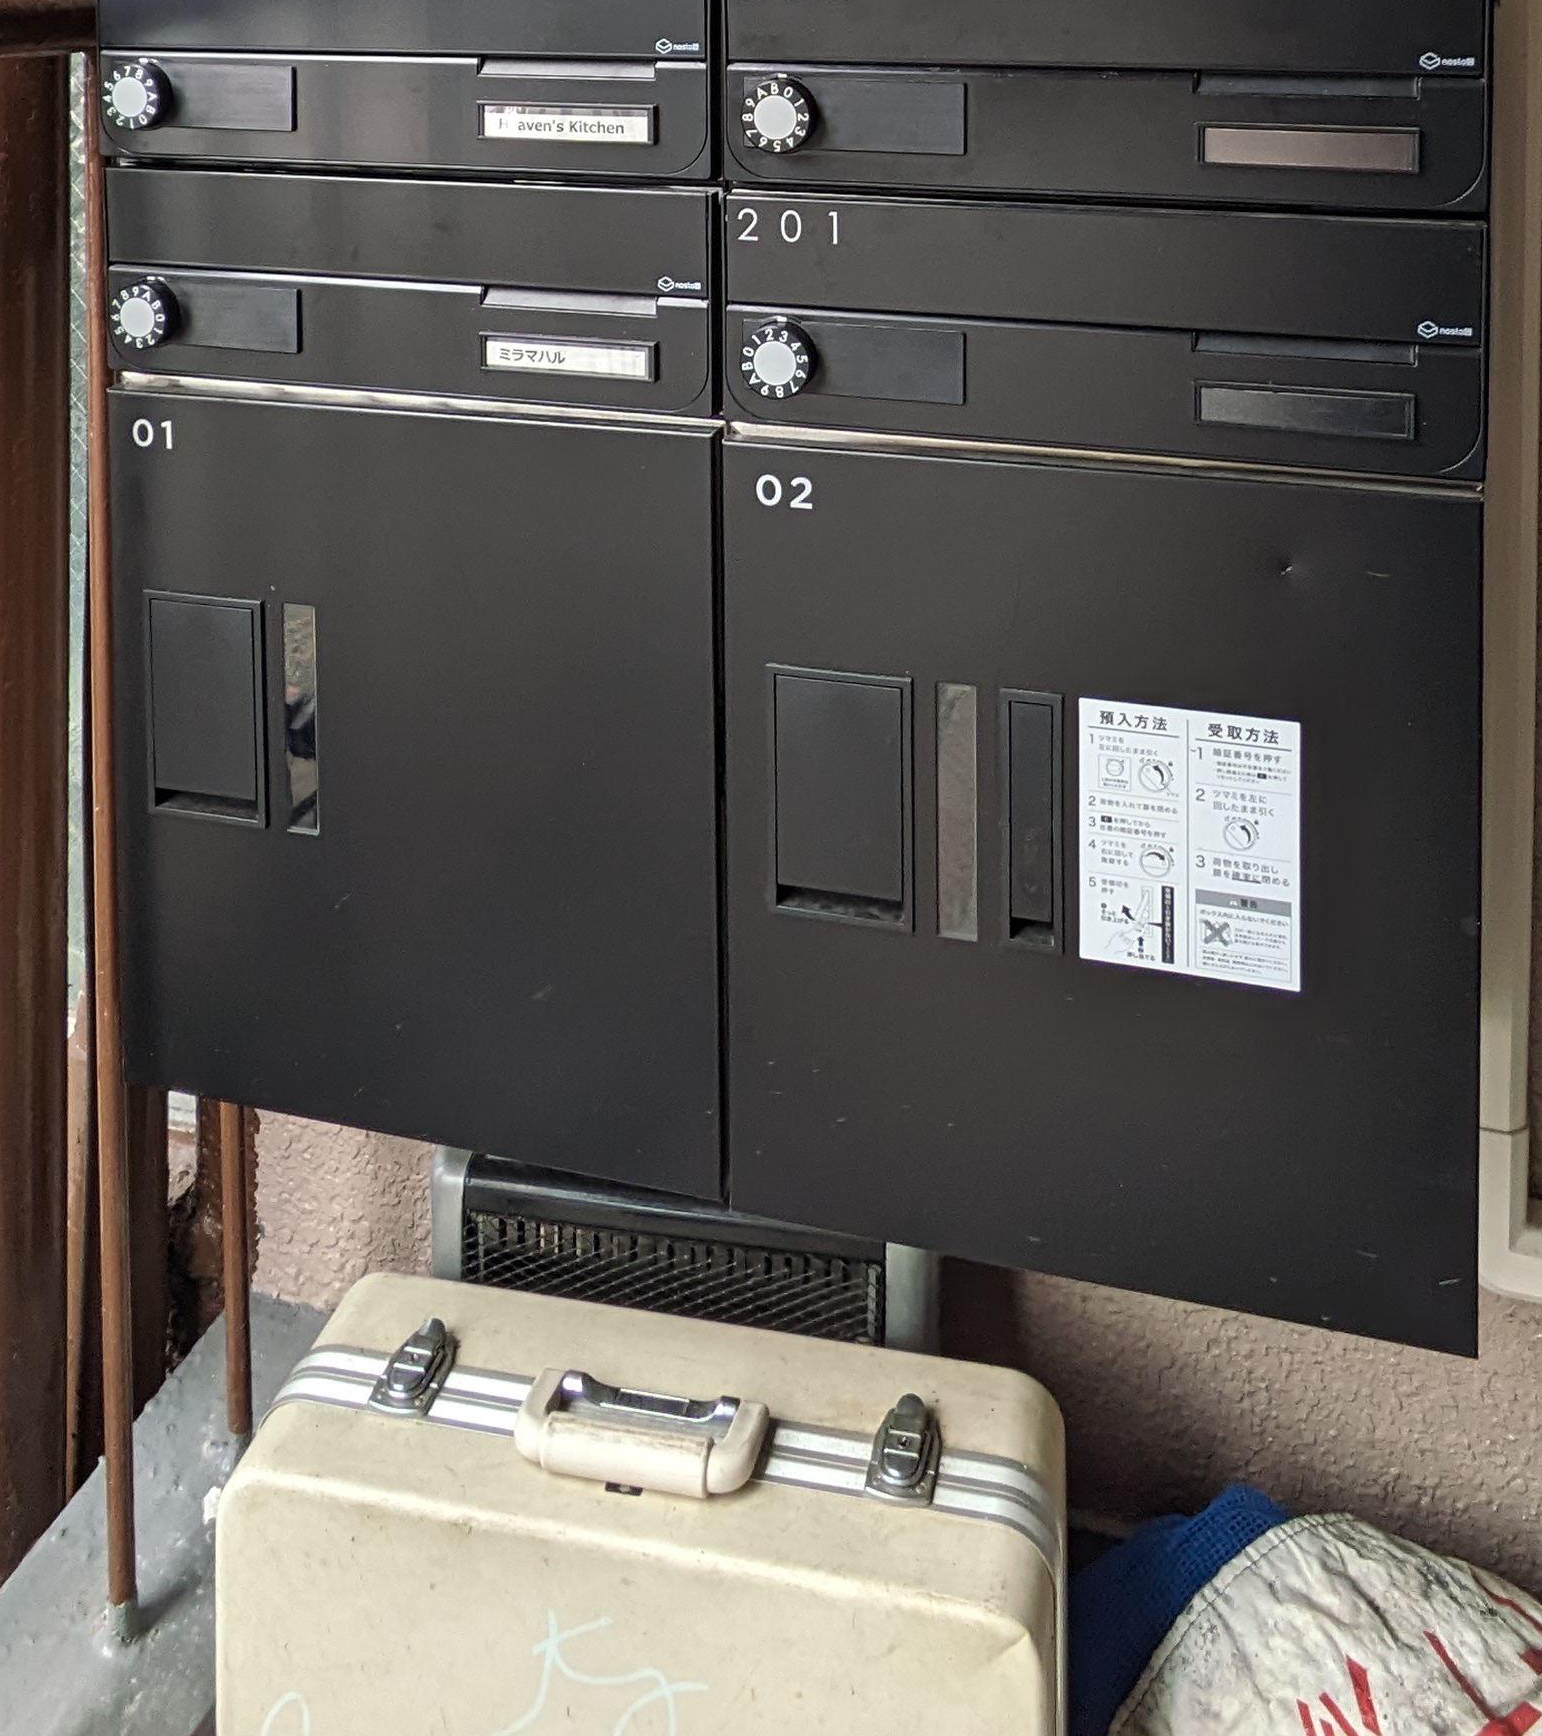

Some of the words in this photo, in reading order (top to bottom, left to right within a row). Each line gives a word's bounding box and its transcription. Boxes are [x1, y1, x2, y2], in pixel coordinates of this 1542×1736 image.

[569, 120, 624, 134] Kitchen
[737, 210, 840, 245] 201
[499, 347, 565, 364] ミラマハル
[132, 419, 175, 449] 01
[755, 474, 813, 509] 02
[1099, 710, 1168, 732] 預入方法
[1089, 733, 1094, 744] 1
[1208, 723, 1279, 745] 受取方法
[1197, 747, 1202, 760] 1
[1088, 795, 1096, 806] 2
[1196, 788, 1205, 802] 2
[1213, 790, 1267, 804] ツマミを左に
[1088, 816, 1096, 827] 3
[1088, 839, 1096, 849] 4
[1195, 855, 1205, 868] 3
[1089, 876, 1096, 887] 5
